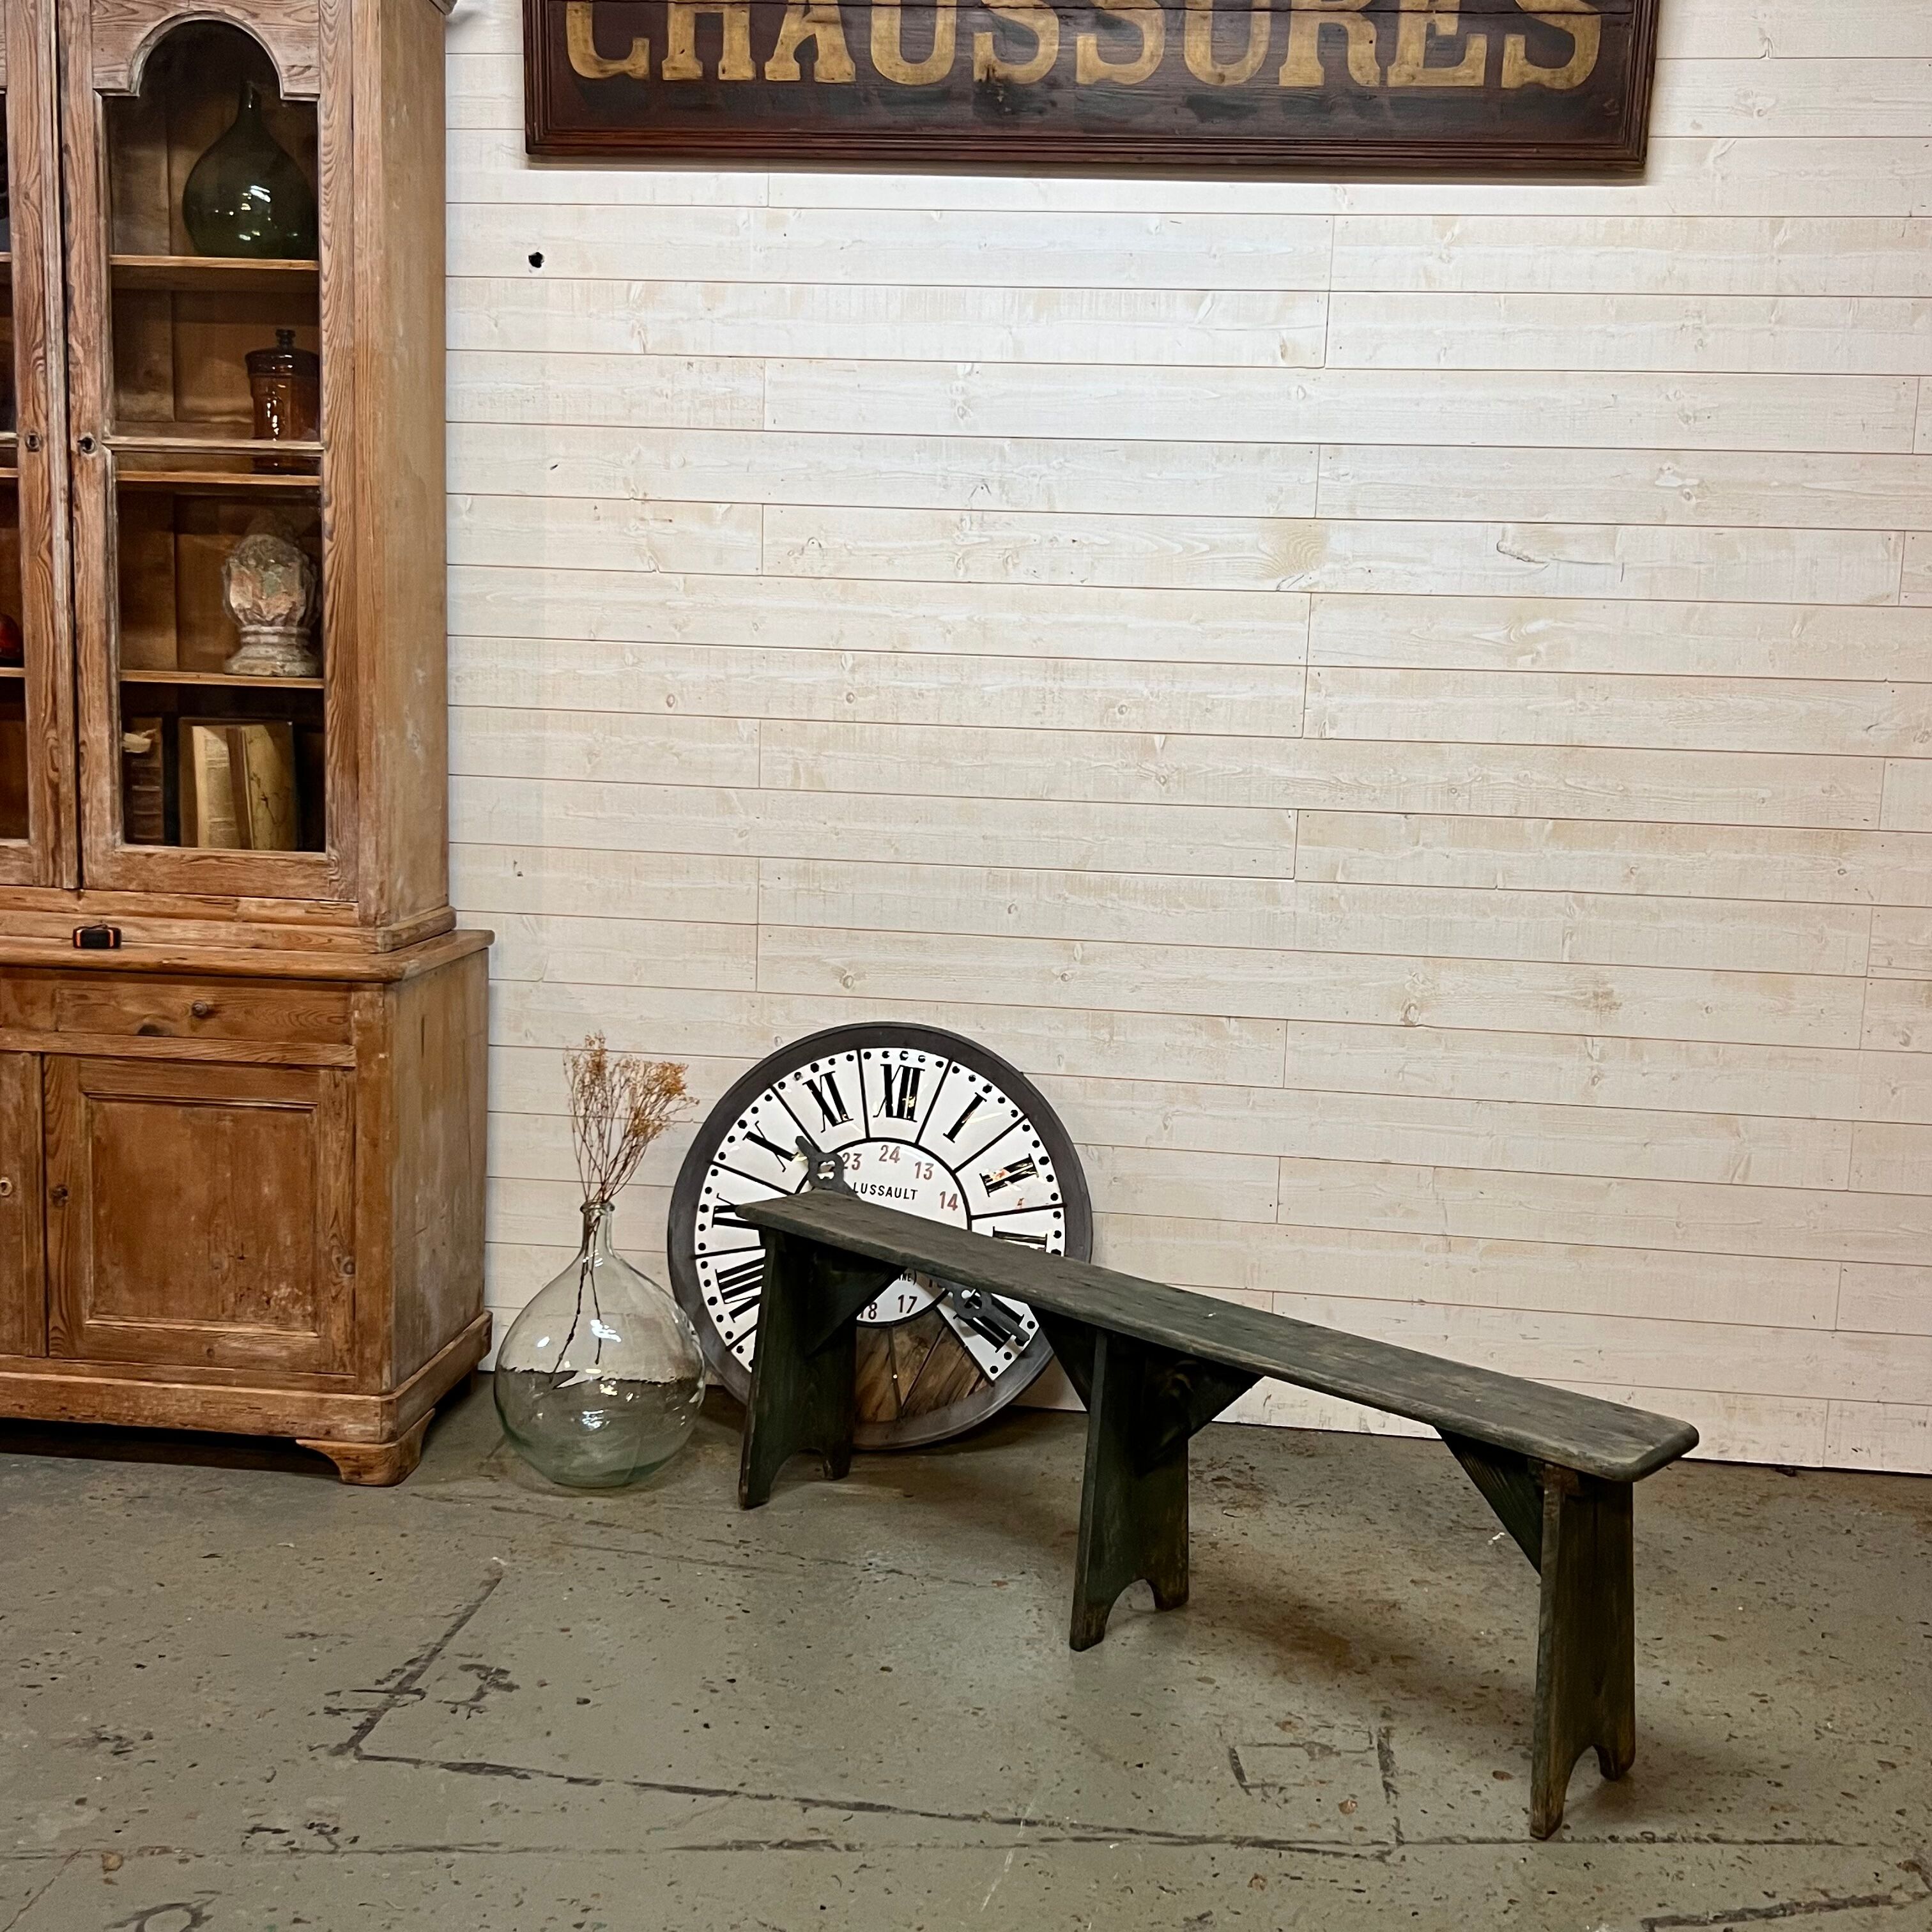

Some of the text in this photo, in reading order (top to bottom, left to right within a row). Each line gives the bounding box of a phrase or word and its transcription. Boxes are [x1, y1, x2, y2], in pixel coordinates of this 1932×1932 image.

[802, 1071, 854, 1133] XI
[873, 1063, 925, 1123] XII
[842, 1152, 862, 1170] 23
[878, 1144, 900, 1163] 24
[914, 1161, 934, 1180] 13
[853, 1182, 919, 1200] LUSSAULT
[939, 1191, 958, 1211] 14
[897, 1294, 918, 1314] 17
